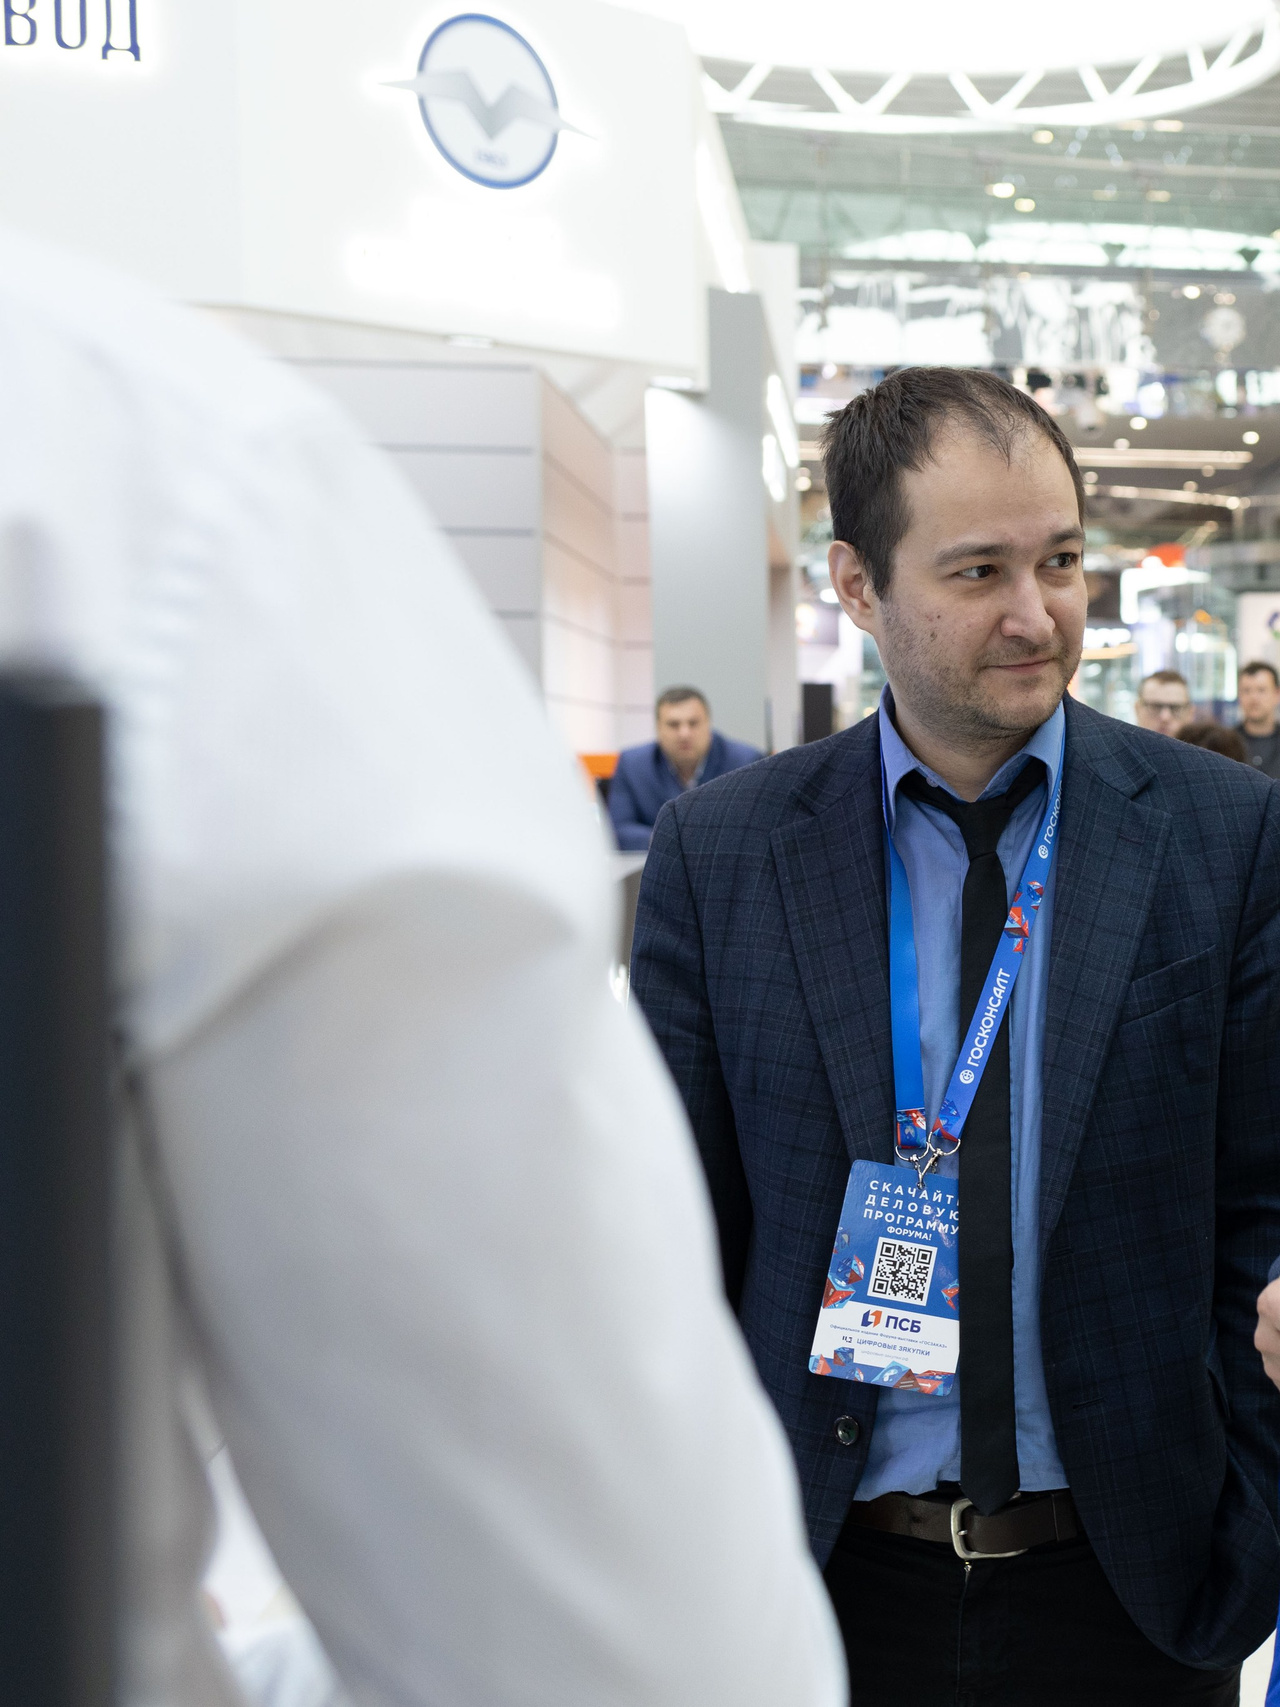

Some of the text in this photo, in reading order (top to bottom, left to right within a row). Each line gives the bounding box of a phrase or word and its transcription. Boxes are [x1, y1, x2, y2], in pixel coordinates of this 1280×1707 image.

[967, 967, 1012, 1067] ГОСКОНСАЛТ
[869, 1180, 959, 1207] СКАЧАЙТ
[863, 1208, 959, 1235] ПРОГРАММУ
[886, 1225, 933, 1241] ФОРУМА!
[885, 1315, 922, 1333] ПСБ
[856, 1338, 897, 1351] ЦИФРОВЫЕ
